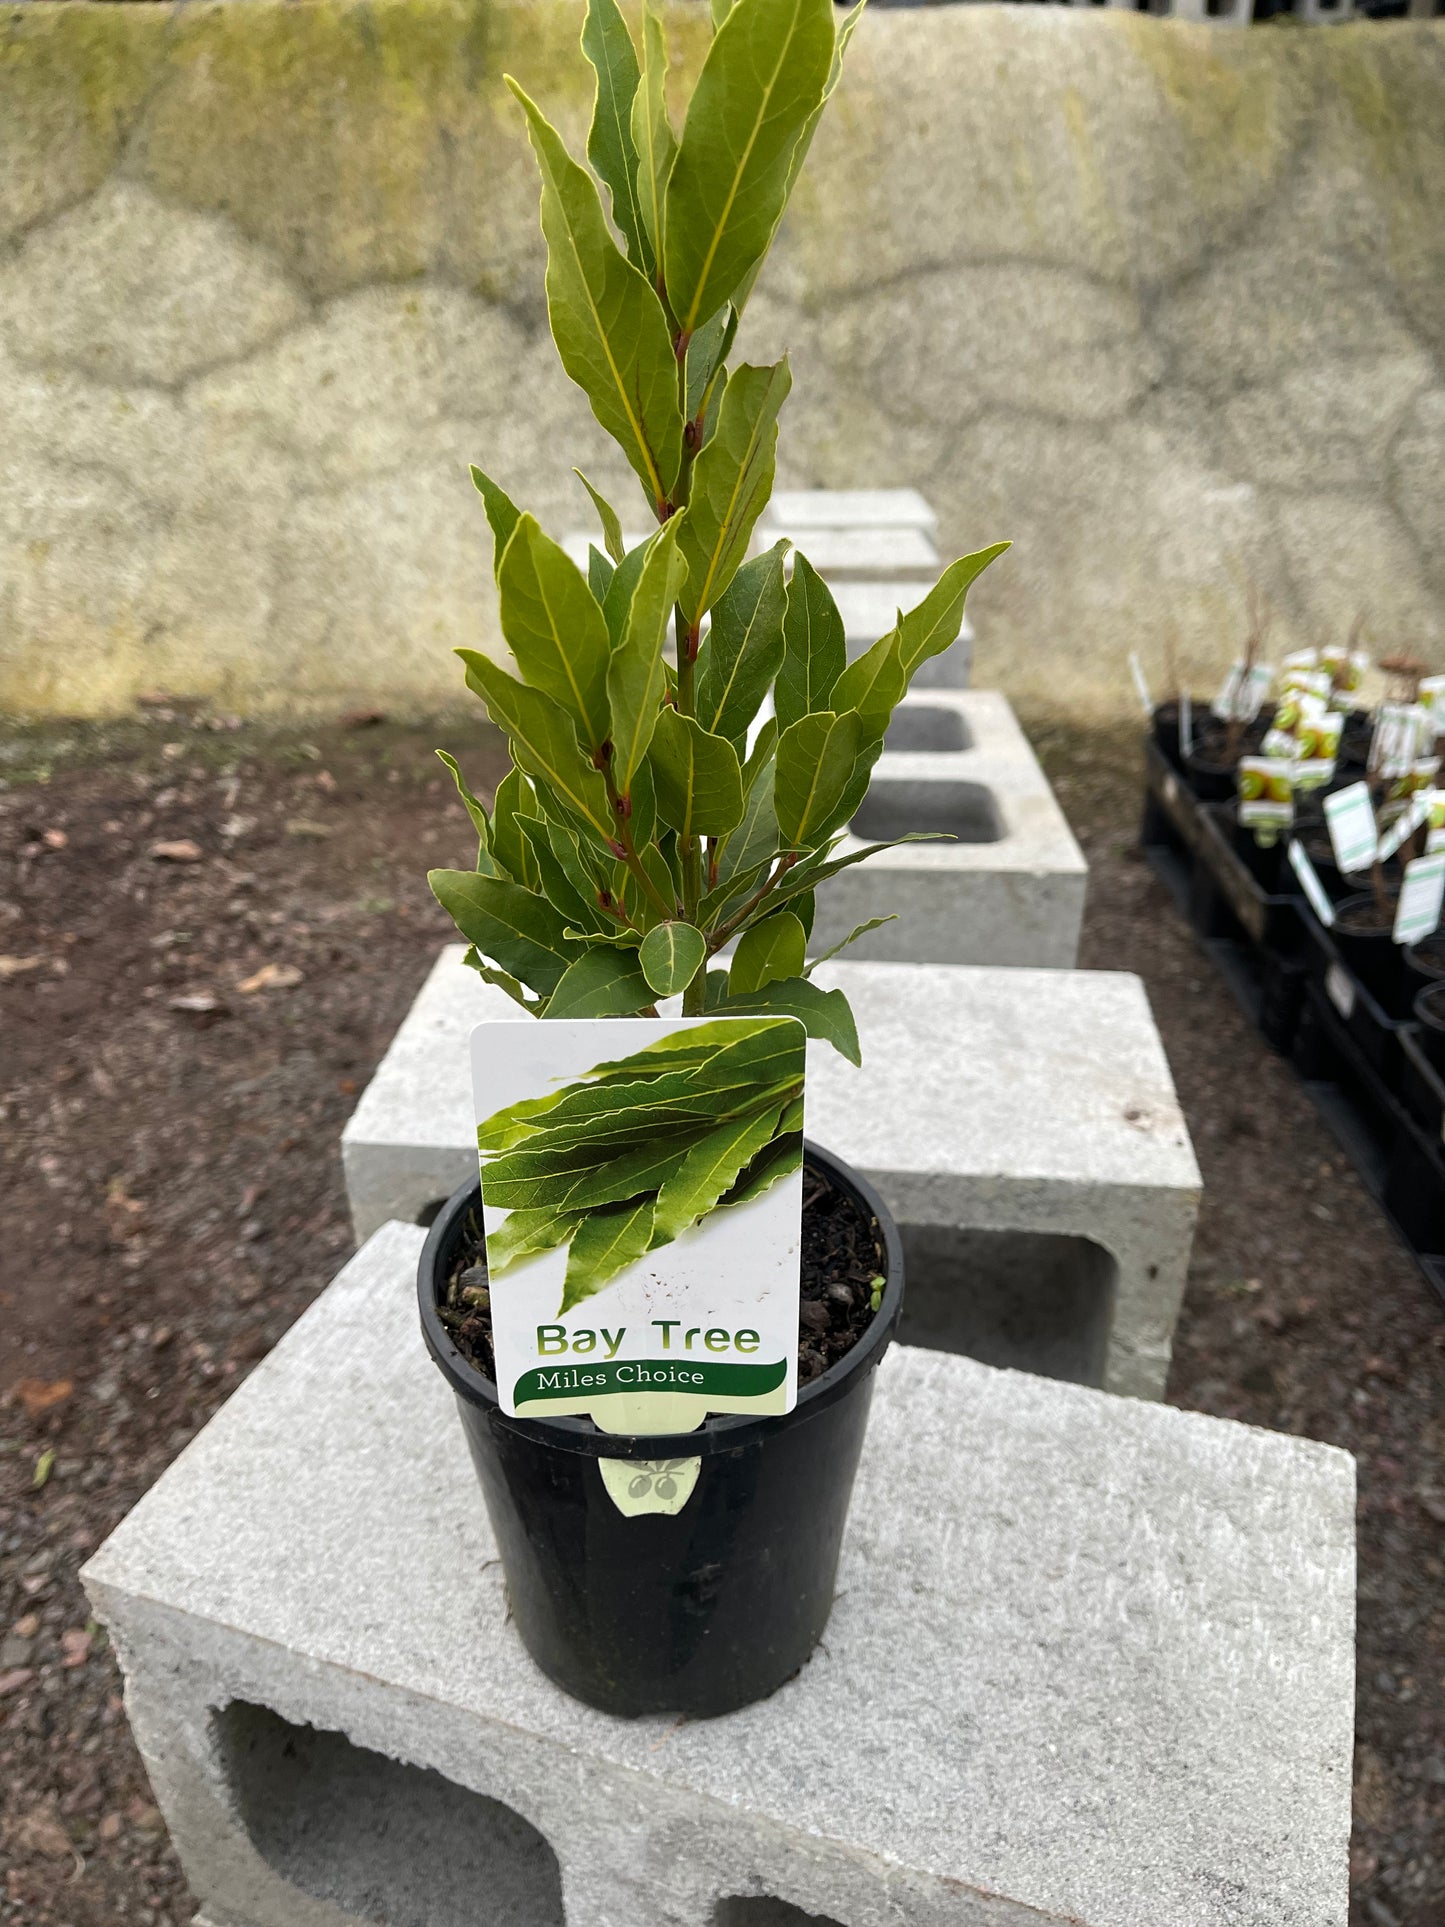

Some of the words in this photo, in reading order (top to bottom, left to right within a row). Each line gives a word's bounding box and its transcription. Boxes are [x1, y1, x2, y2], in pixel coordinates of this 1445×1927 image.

[536, 1323, 627, 1359] Bay
[651, 1320, 761, 1354] Tree
[537, 1369, 607, 1390] Miles
[615, 1364, 705, 1385] Choice
